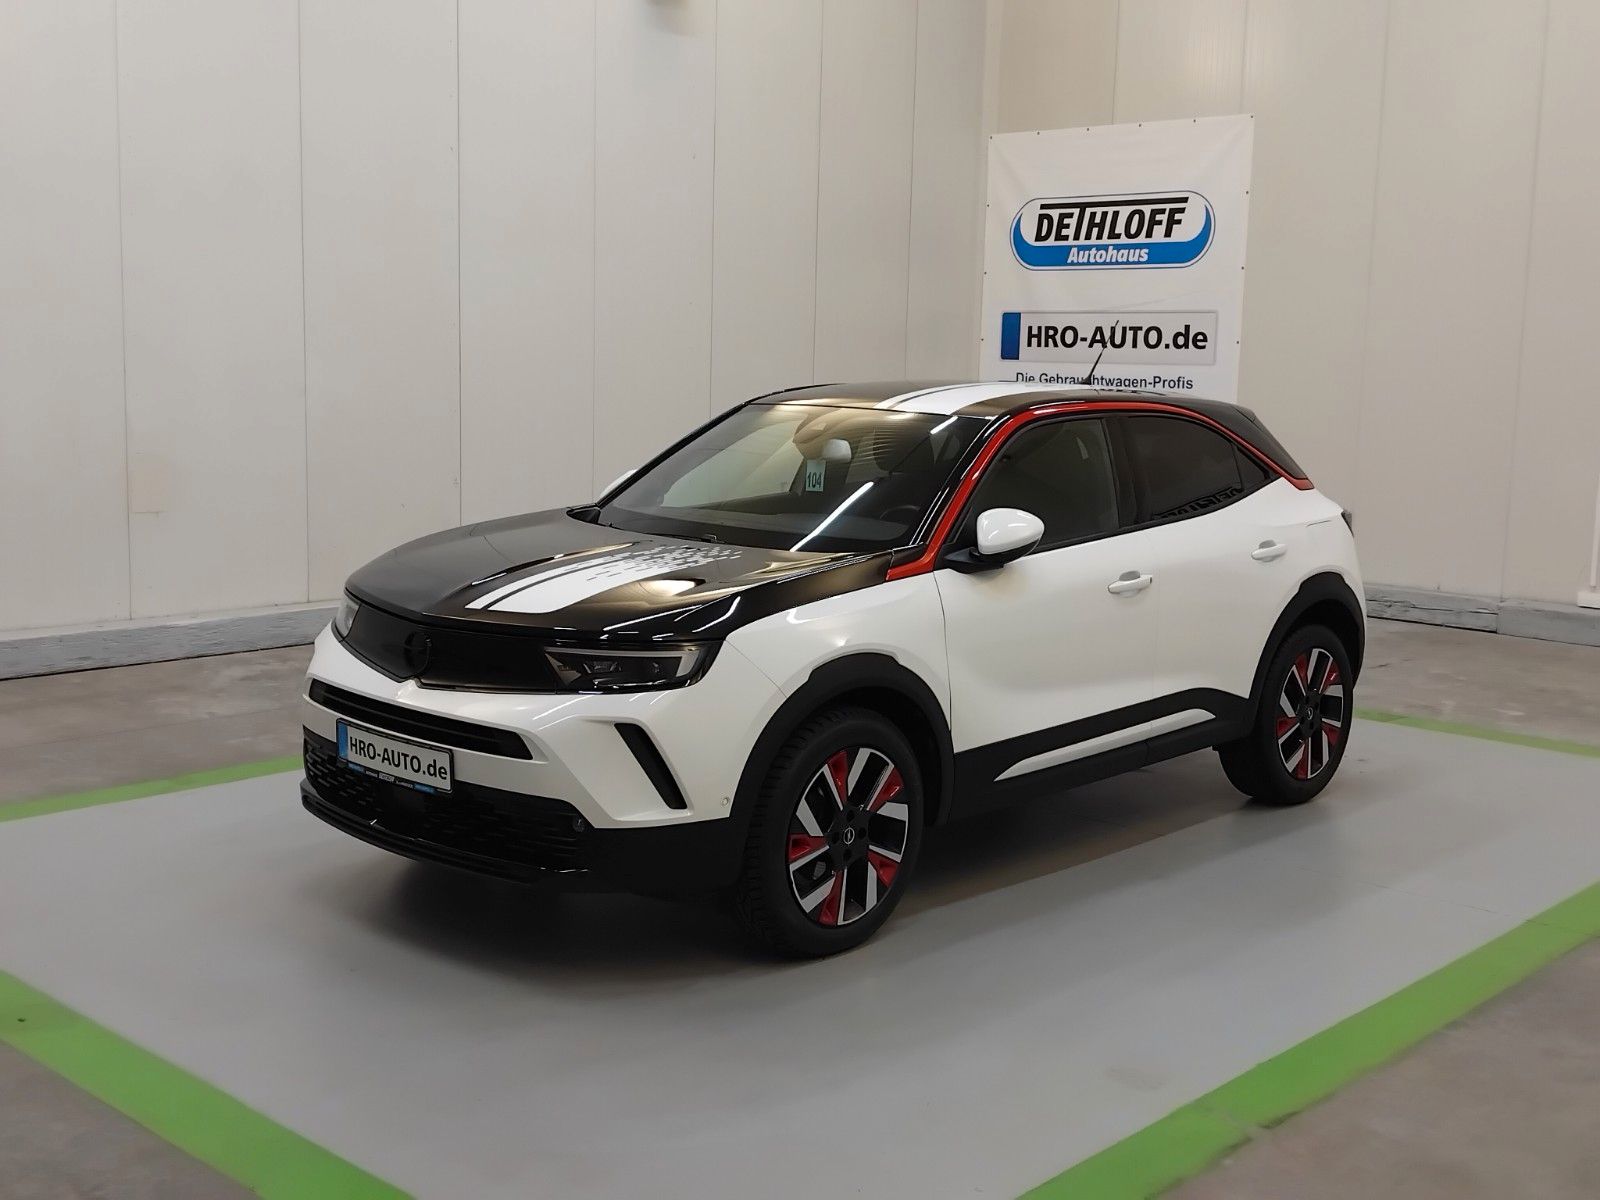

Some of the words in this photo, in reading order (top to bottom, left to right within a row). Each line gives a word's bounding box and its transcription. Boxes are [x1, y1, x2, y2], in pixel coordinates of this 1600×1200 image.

[1035, 197, 1189, 242] DETHLOFF
[1067, 245, 1149, 264] Autohaus
[1027, 324, 1208, 350] HRO-AUTO.de
[1015, 372, 1035, 383] Die
[1039, 373, 1194, 389] Gebrauhtwagen-Profis
[807, 472, 822, 488] 104
[350, 736, 448, 780] HRO-AUTO.de
